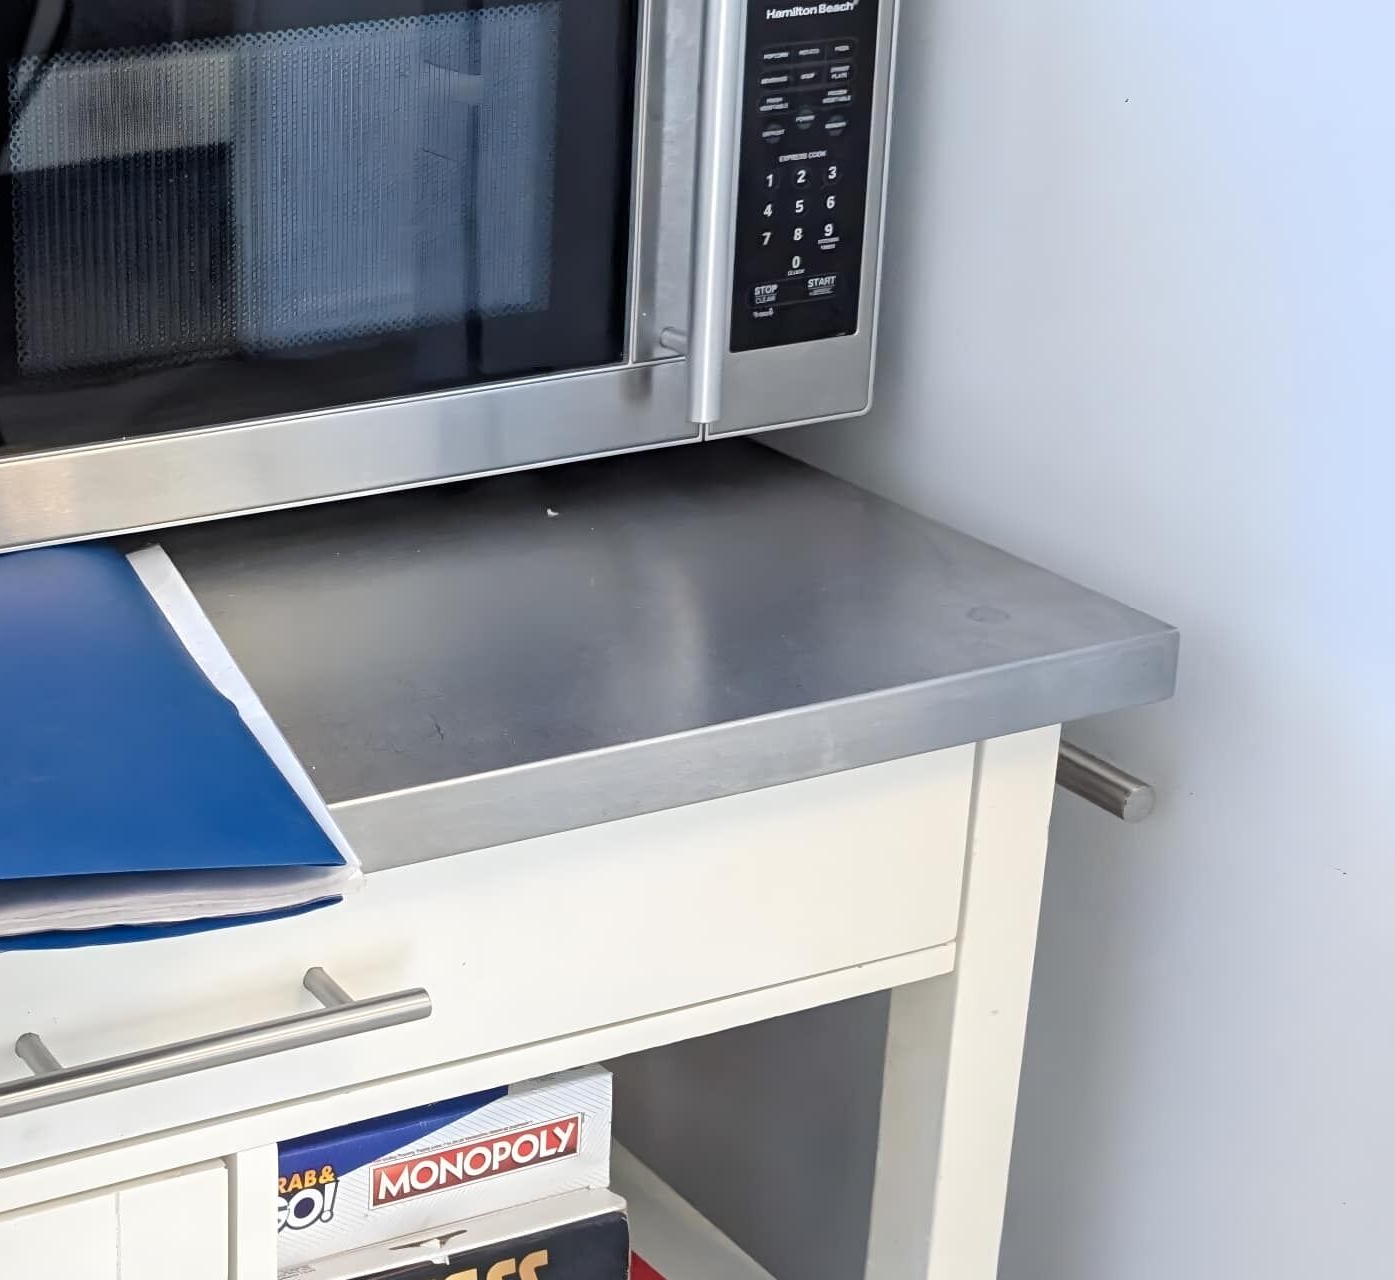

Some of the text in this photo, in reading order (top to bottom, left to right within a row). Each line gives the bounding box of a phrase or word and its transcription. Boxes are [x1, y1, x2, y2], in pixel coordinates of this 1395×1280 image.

[766, 6, 817, 19] Hamilton
[766, 166, 837, 187] 1 2 3
[764, 196, 835, 216] 4 5 6
[762, 224, 833, 245] 7 8 9
[792, 256, 800, 268] 0
[754, 284, 778, 295] STOP
[808, 276, 836, 287] START
[378, 1121, 576, 1200] MONOPOLY
